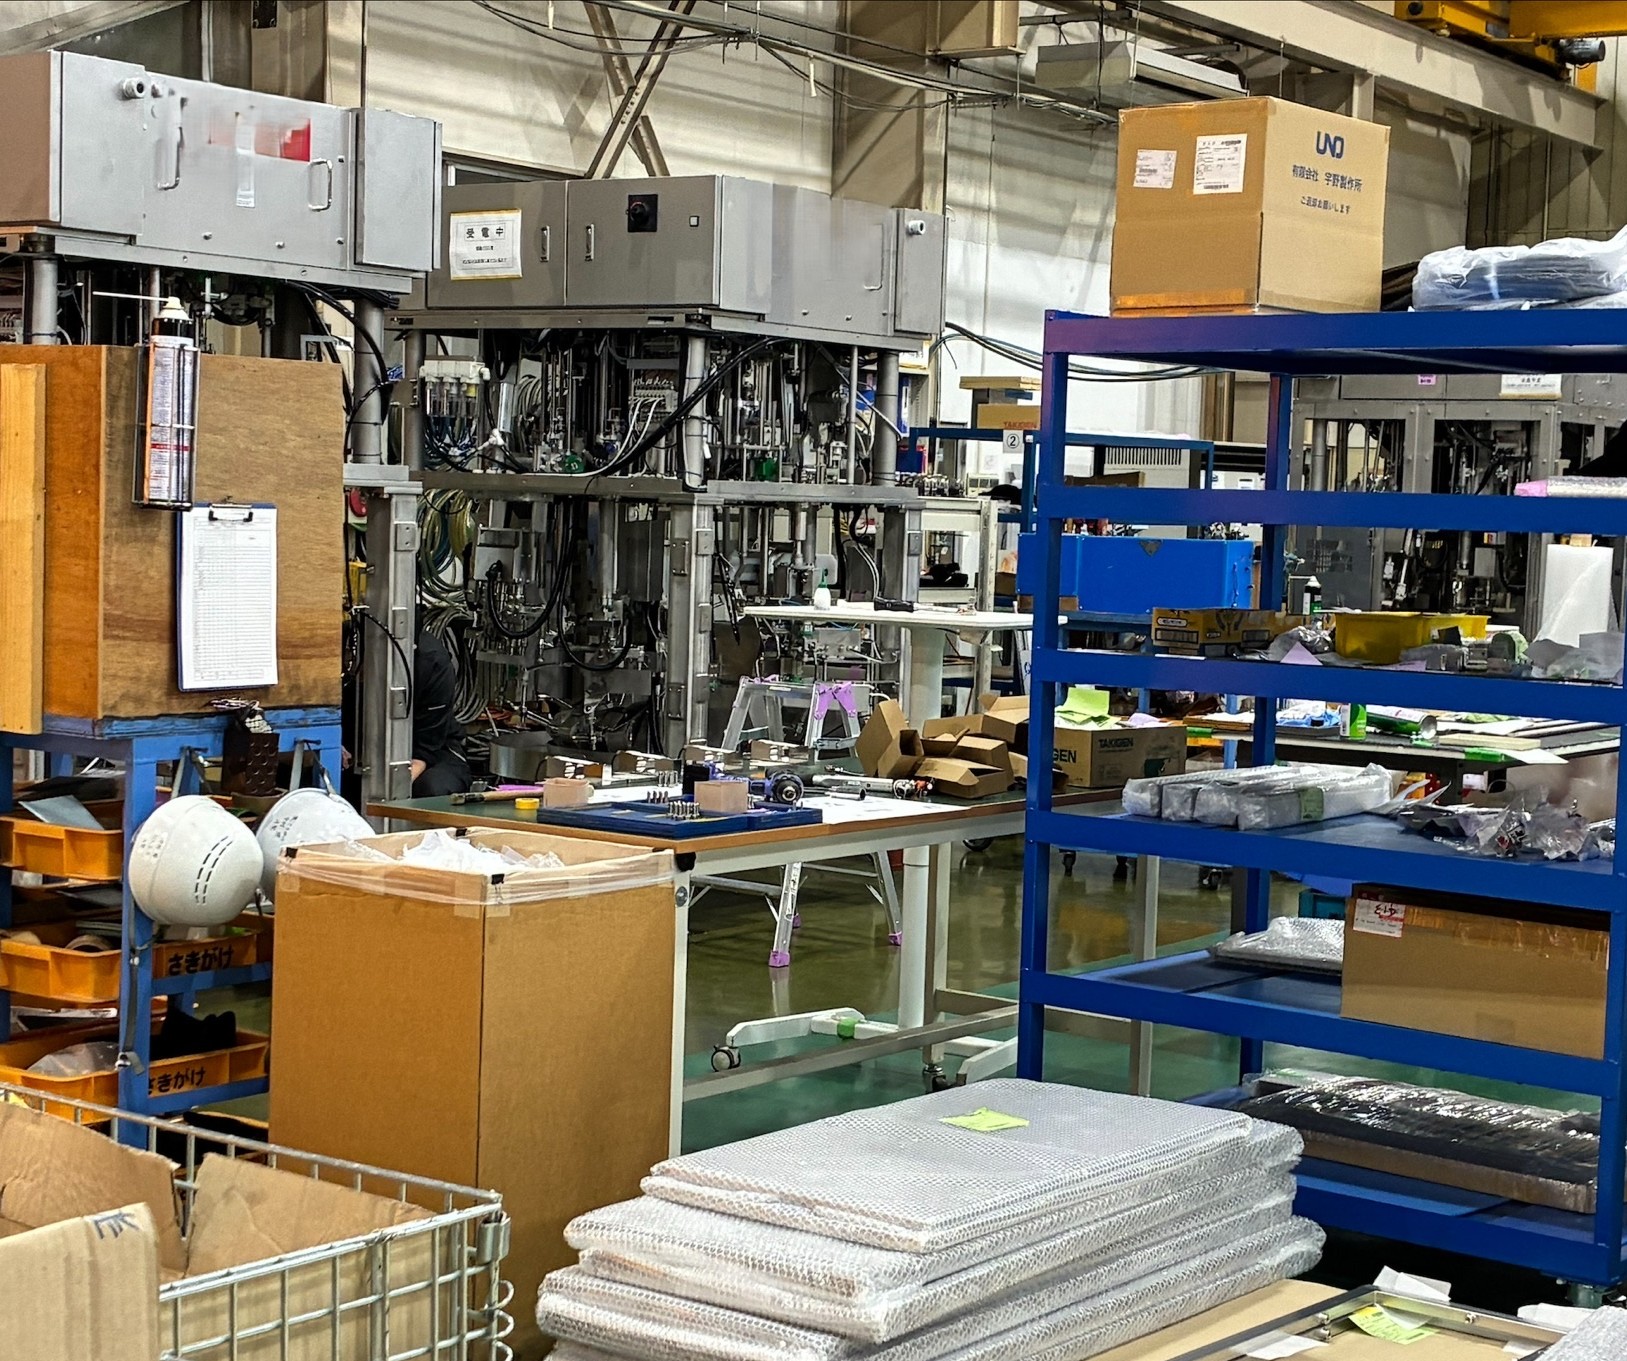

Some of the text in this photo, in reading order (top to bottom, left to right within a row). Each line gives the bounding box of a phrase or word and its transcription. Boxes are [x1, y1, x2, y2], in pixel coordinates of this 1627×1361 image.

[1315, 131, 1345, 159] UNO
[1292, 164, 1319, 182] 有限会社
[167, 945, 234, 976] さきがけ
